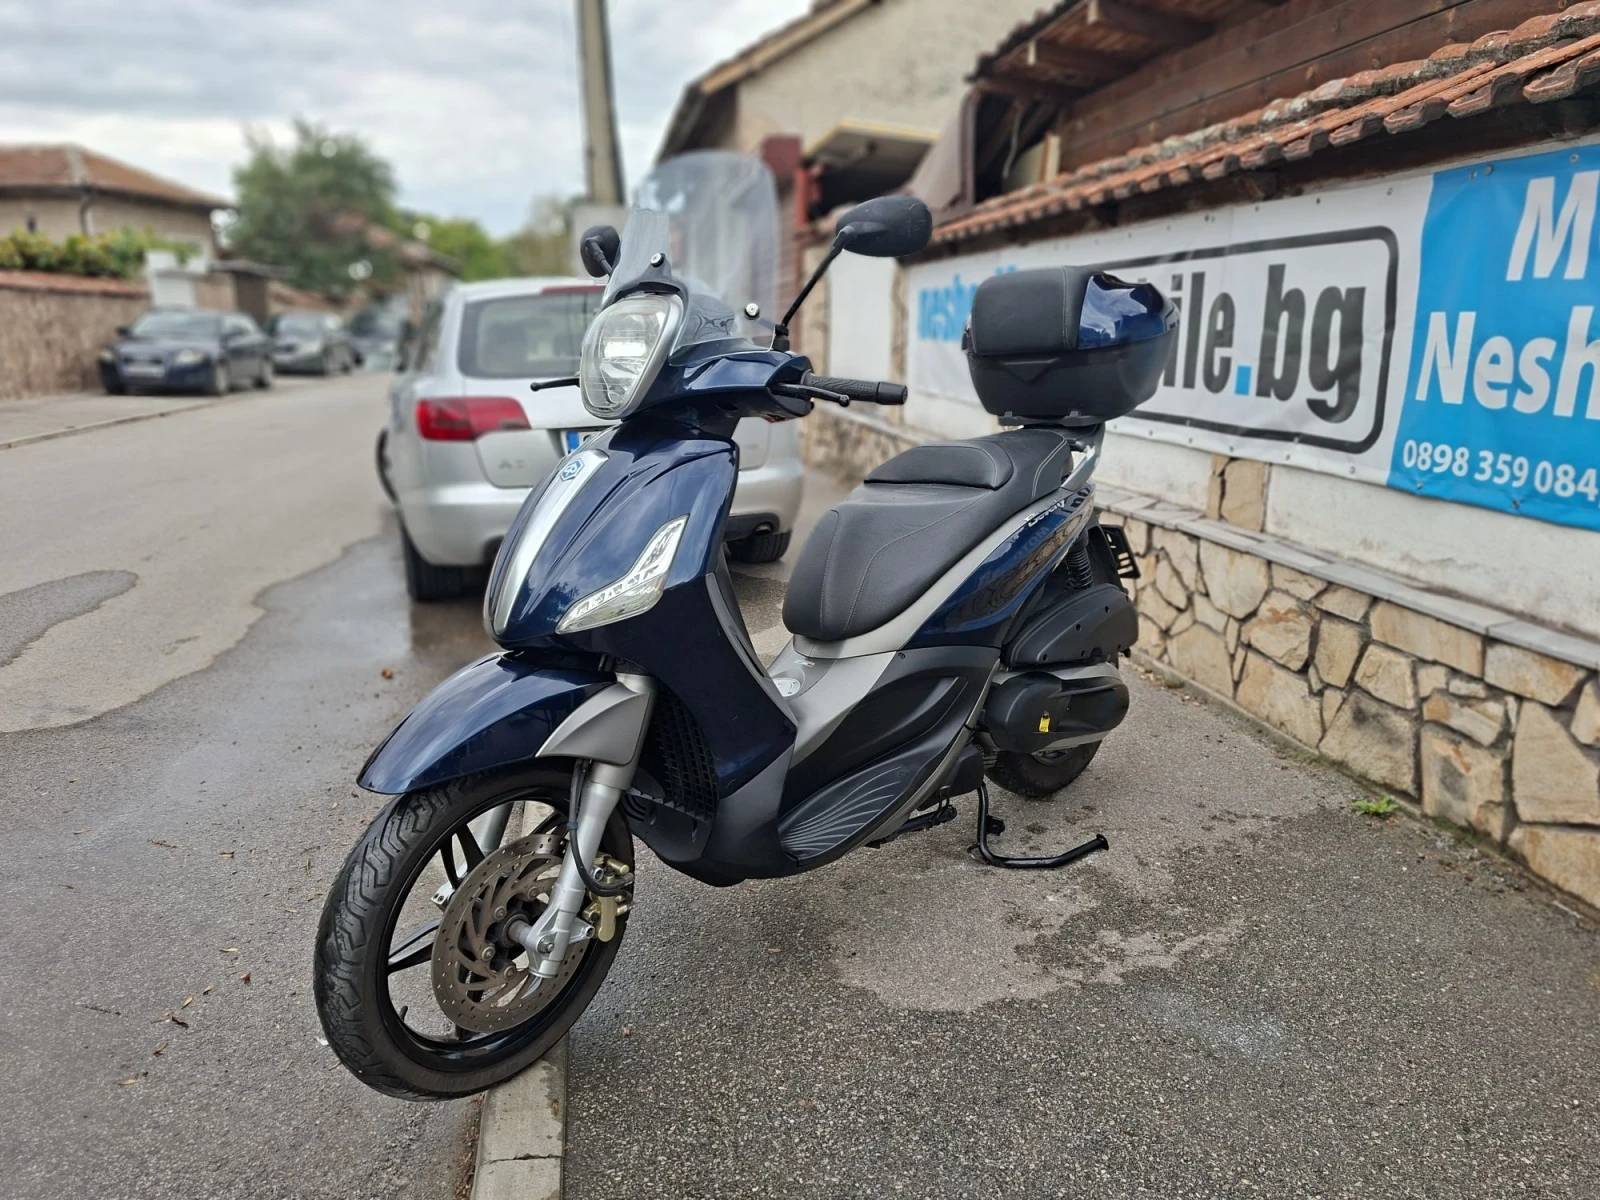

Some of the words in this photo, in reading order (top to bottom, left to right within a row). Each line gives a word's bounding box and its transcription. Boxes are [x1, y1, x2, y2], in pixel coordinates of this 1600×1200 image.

[1505, 170, 1600, 281] M
[1163, 264, 1367, 424] ile.bg
[1403, 439, 1470, 477] 0898
[1474, 449, 1530, 488] 359
